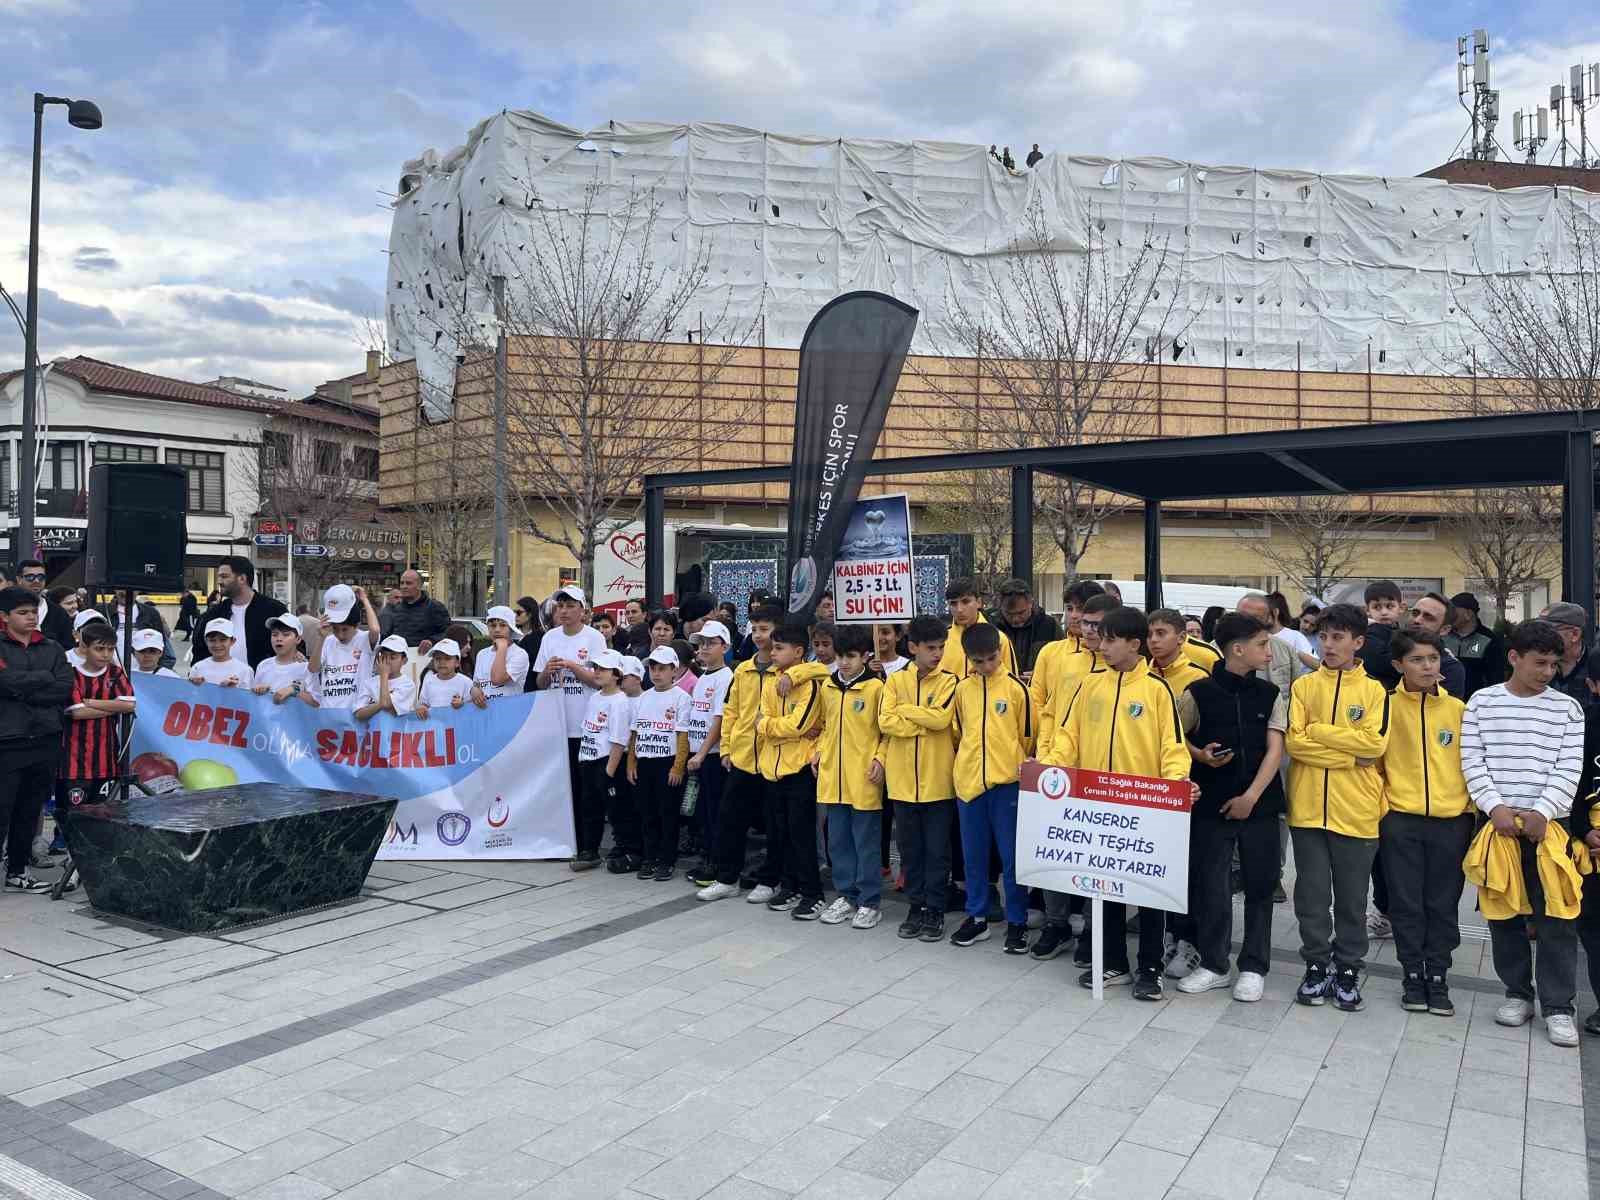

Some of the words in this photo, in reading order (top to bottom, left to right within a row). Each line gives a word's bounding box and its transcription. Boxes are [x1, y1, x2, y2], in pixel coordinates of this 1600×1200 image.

[828, 403, 849, 449] SPOR
[836, 562, 885, 577] KALBİNİZ
[887, 560, 909, 576] İÇİN
[846, 579, 863, 594] 2,5
[875, 578, 882, 592] 3
[886, 577, 902, 591] Lt.
[846, 598, 865, 614] SU
[868, 594, 904, 616] İÇİN!
[162, 701, 251, 749] OBEZ
[457, 743, 480, 765] OL
[1063, 808, 1140, 830] KANSERDE
[1047, 826, 1093, 845] ERKEN
[1098, 834, 1154, 854] TEŞHİS
[1035, 846, 1084, 865] HAYAT
[1088, 855, 1167, 879] KURTARIR!
